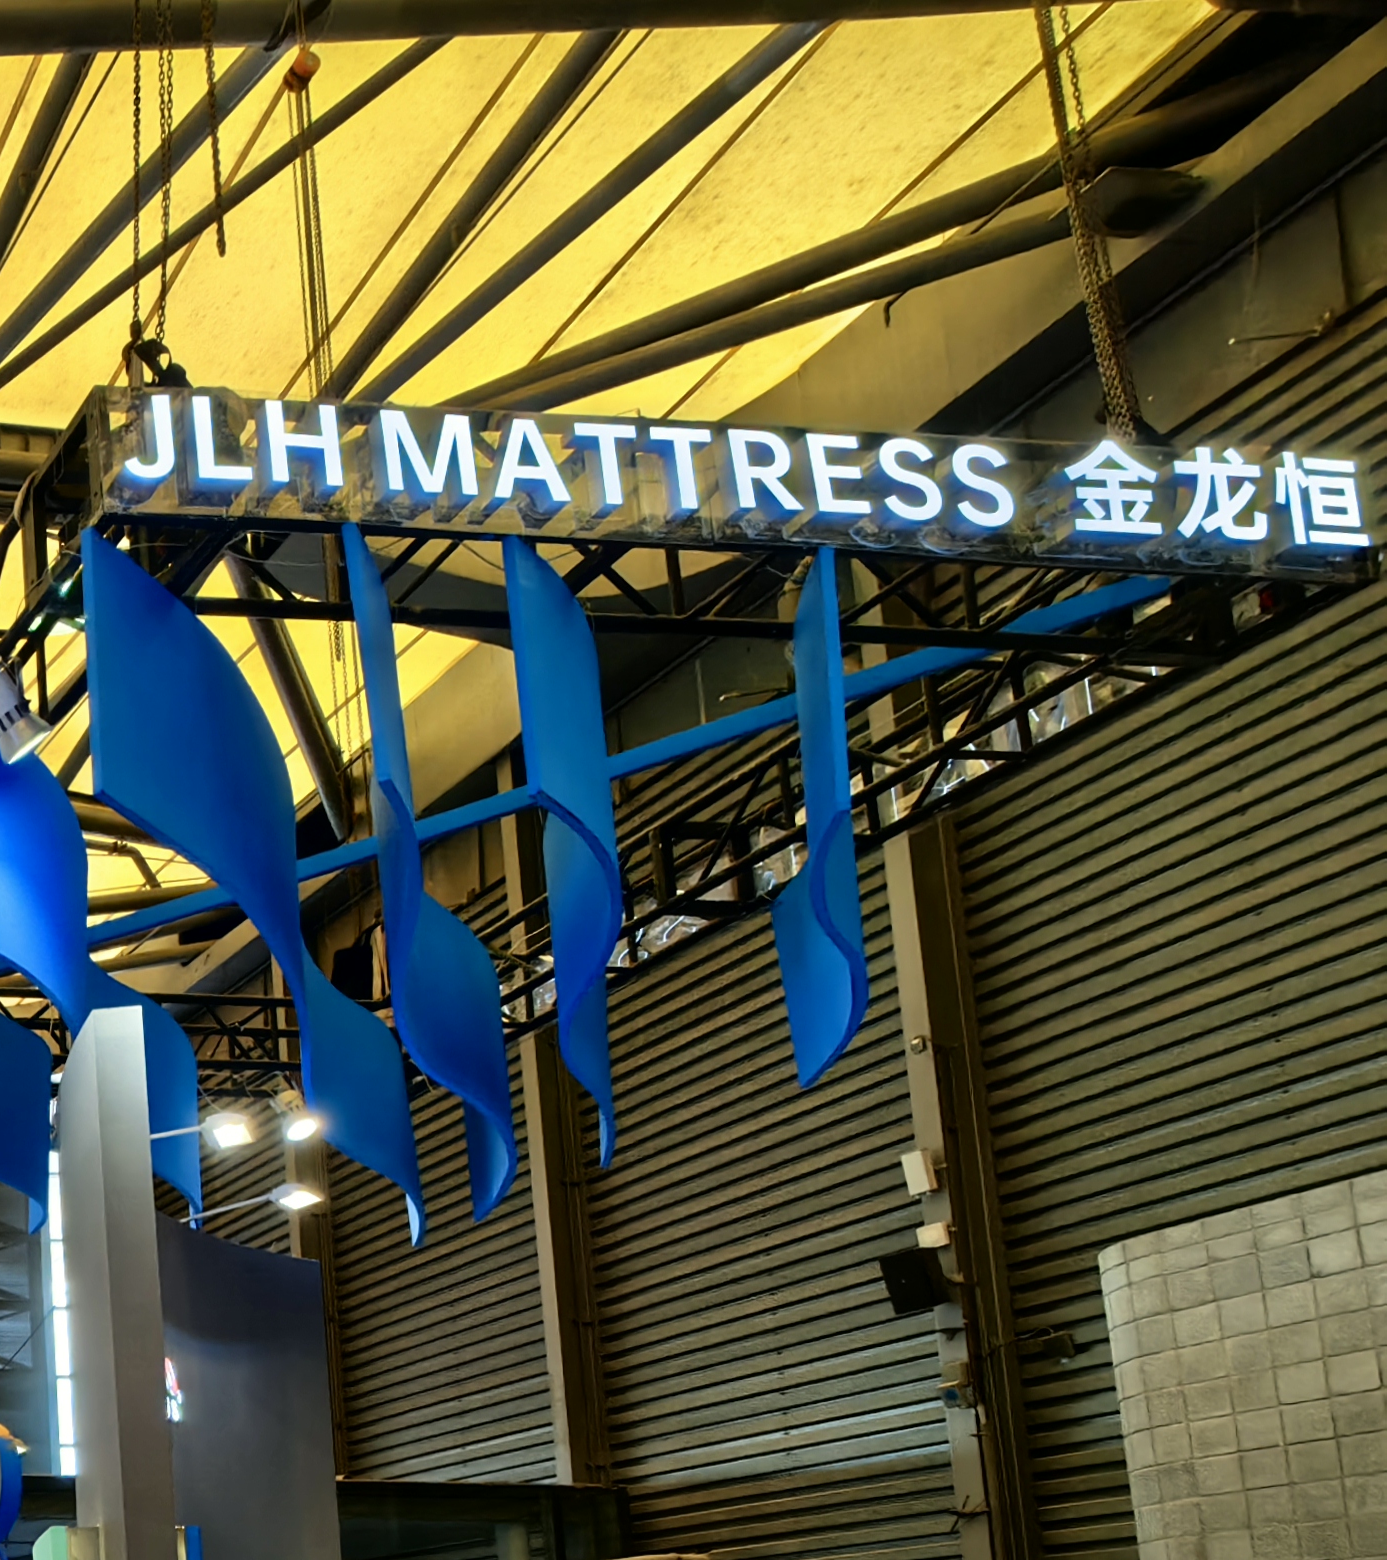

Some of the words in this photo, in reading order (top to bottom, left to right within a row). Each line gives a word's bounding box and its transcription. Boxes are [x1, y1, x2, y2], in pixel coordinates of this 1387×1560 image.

[124, 393, 344, 488] JLH
[378, 408, 1015, 528] MATTRESS
[1063, 439, 1371, 547] 金龙恒
